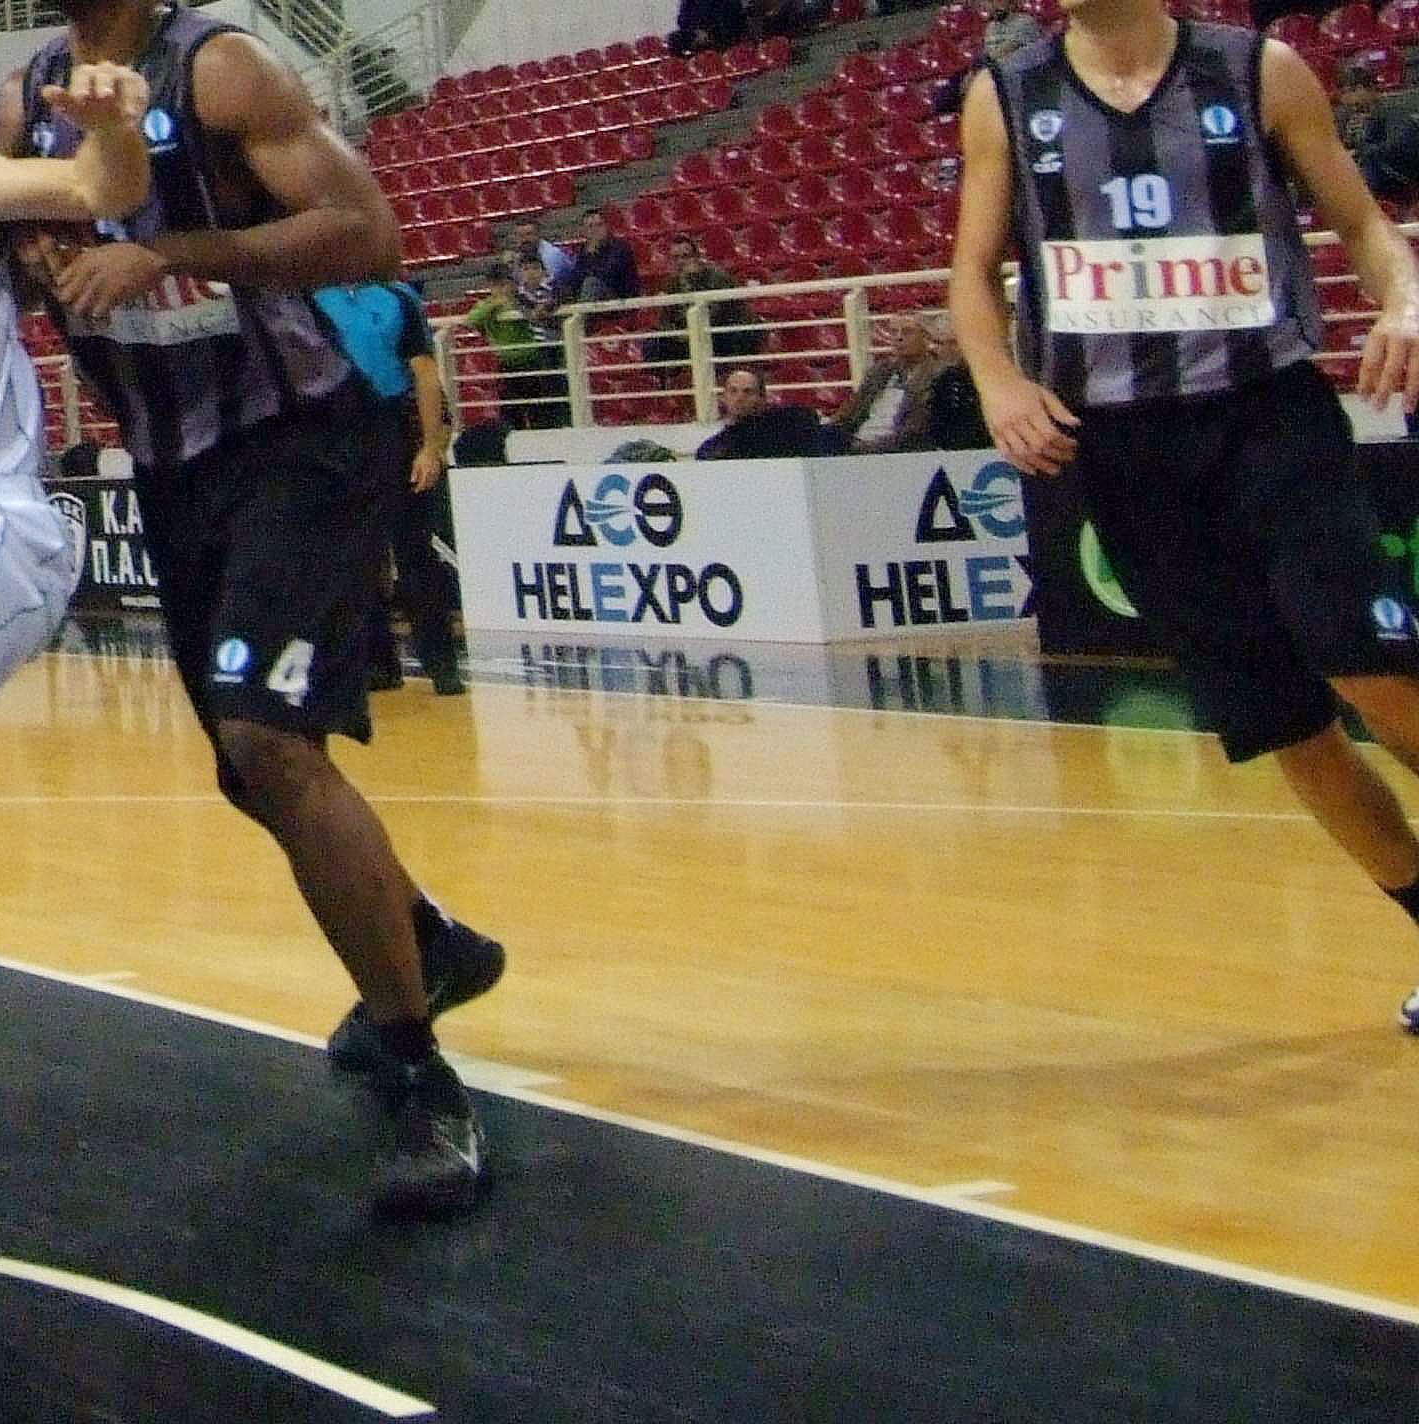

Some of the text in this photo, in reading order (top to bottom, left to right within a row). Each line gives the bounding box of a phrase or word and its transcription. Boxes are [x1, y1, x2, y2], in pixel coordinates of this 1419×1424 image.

[1100, 173, 1173, 230] 19
[1049, 241, 1263, 301] Prime
[510, 560, 745, 628] HELEXPO
[268, 639, 314, 706] 4
